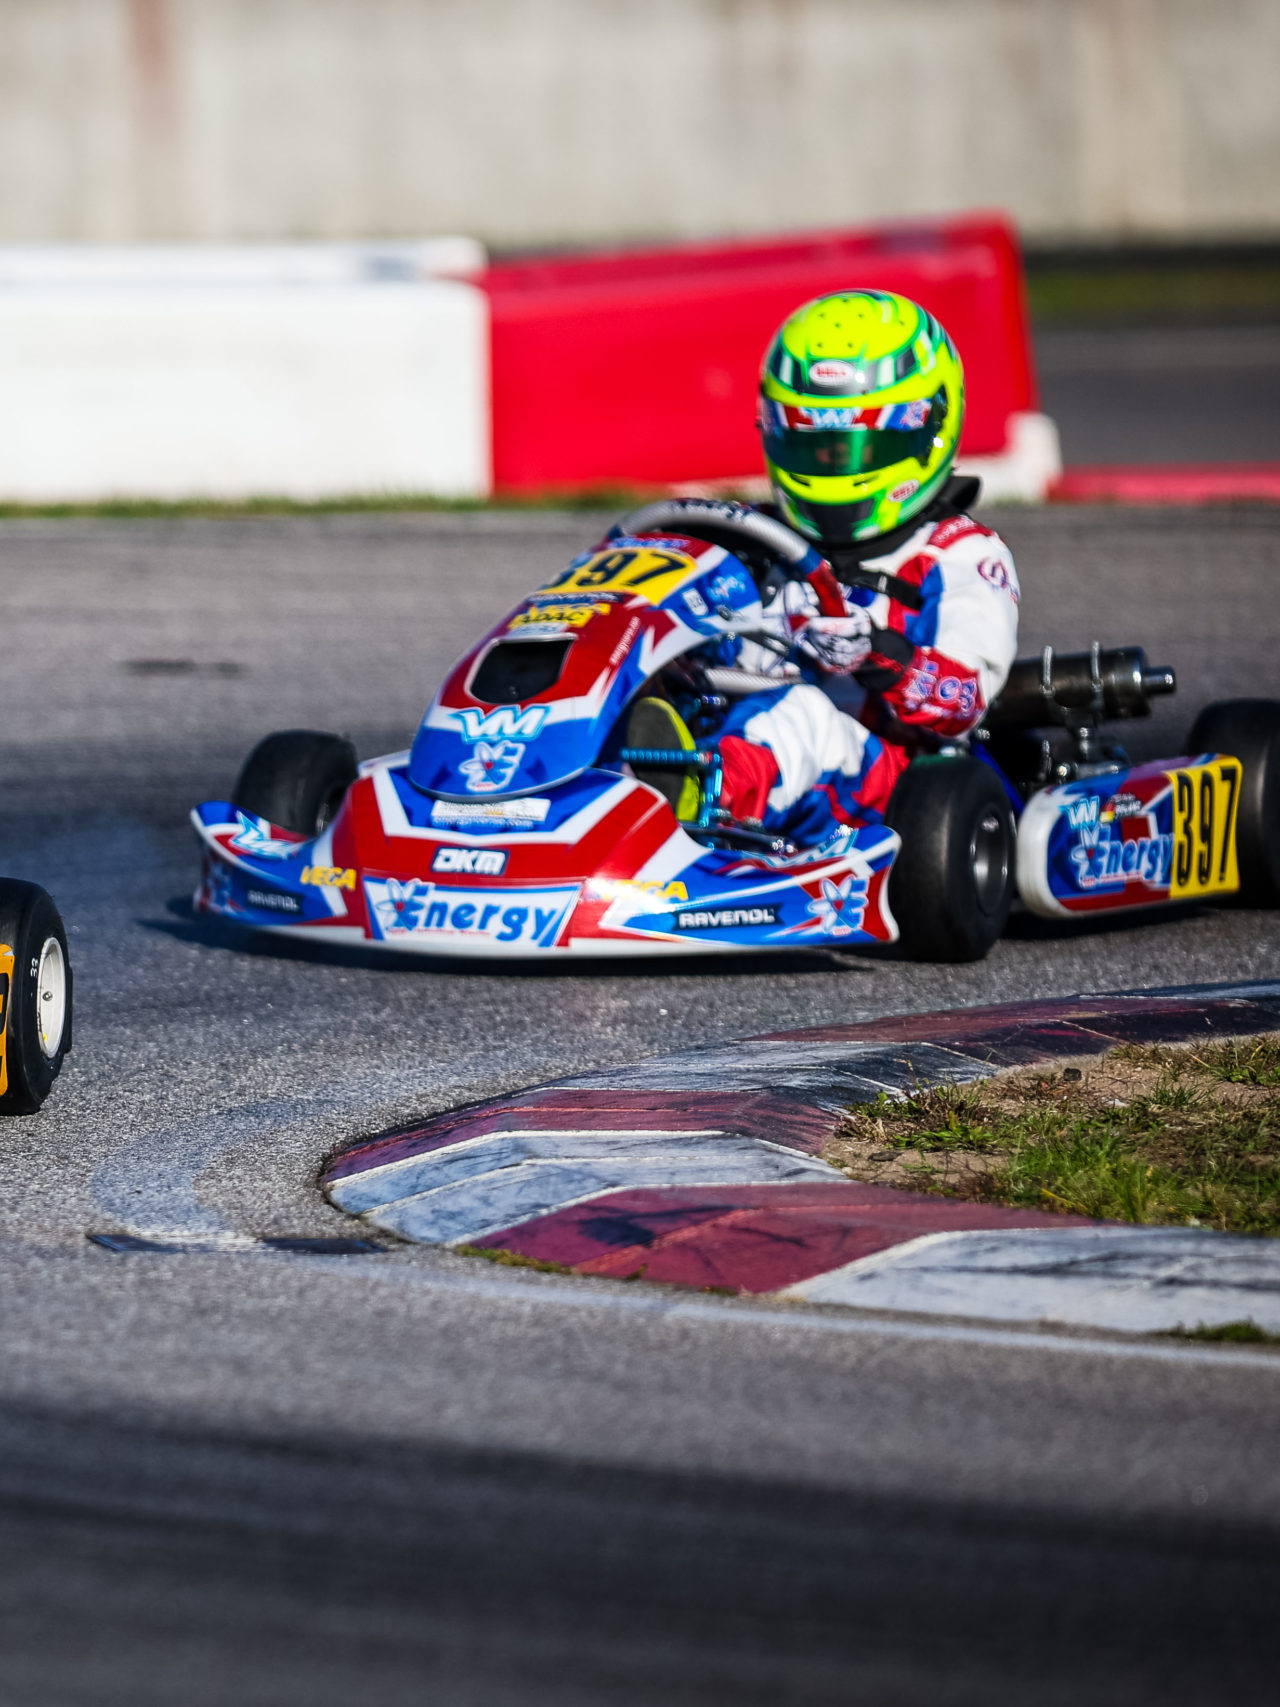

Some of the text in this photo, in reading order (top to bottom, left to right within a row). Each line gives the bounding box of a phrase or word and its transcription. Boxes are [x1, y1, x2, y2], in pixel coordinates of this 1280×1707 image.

[1177, 767, 1237, 887] 397
[432, 847, 505, 875] DKM
[300, 865, 357, 891] VEGA
[375, 878, 557, 942] Energy
[679, 908, 775, 928] RAVENOL
